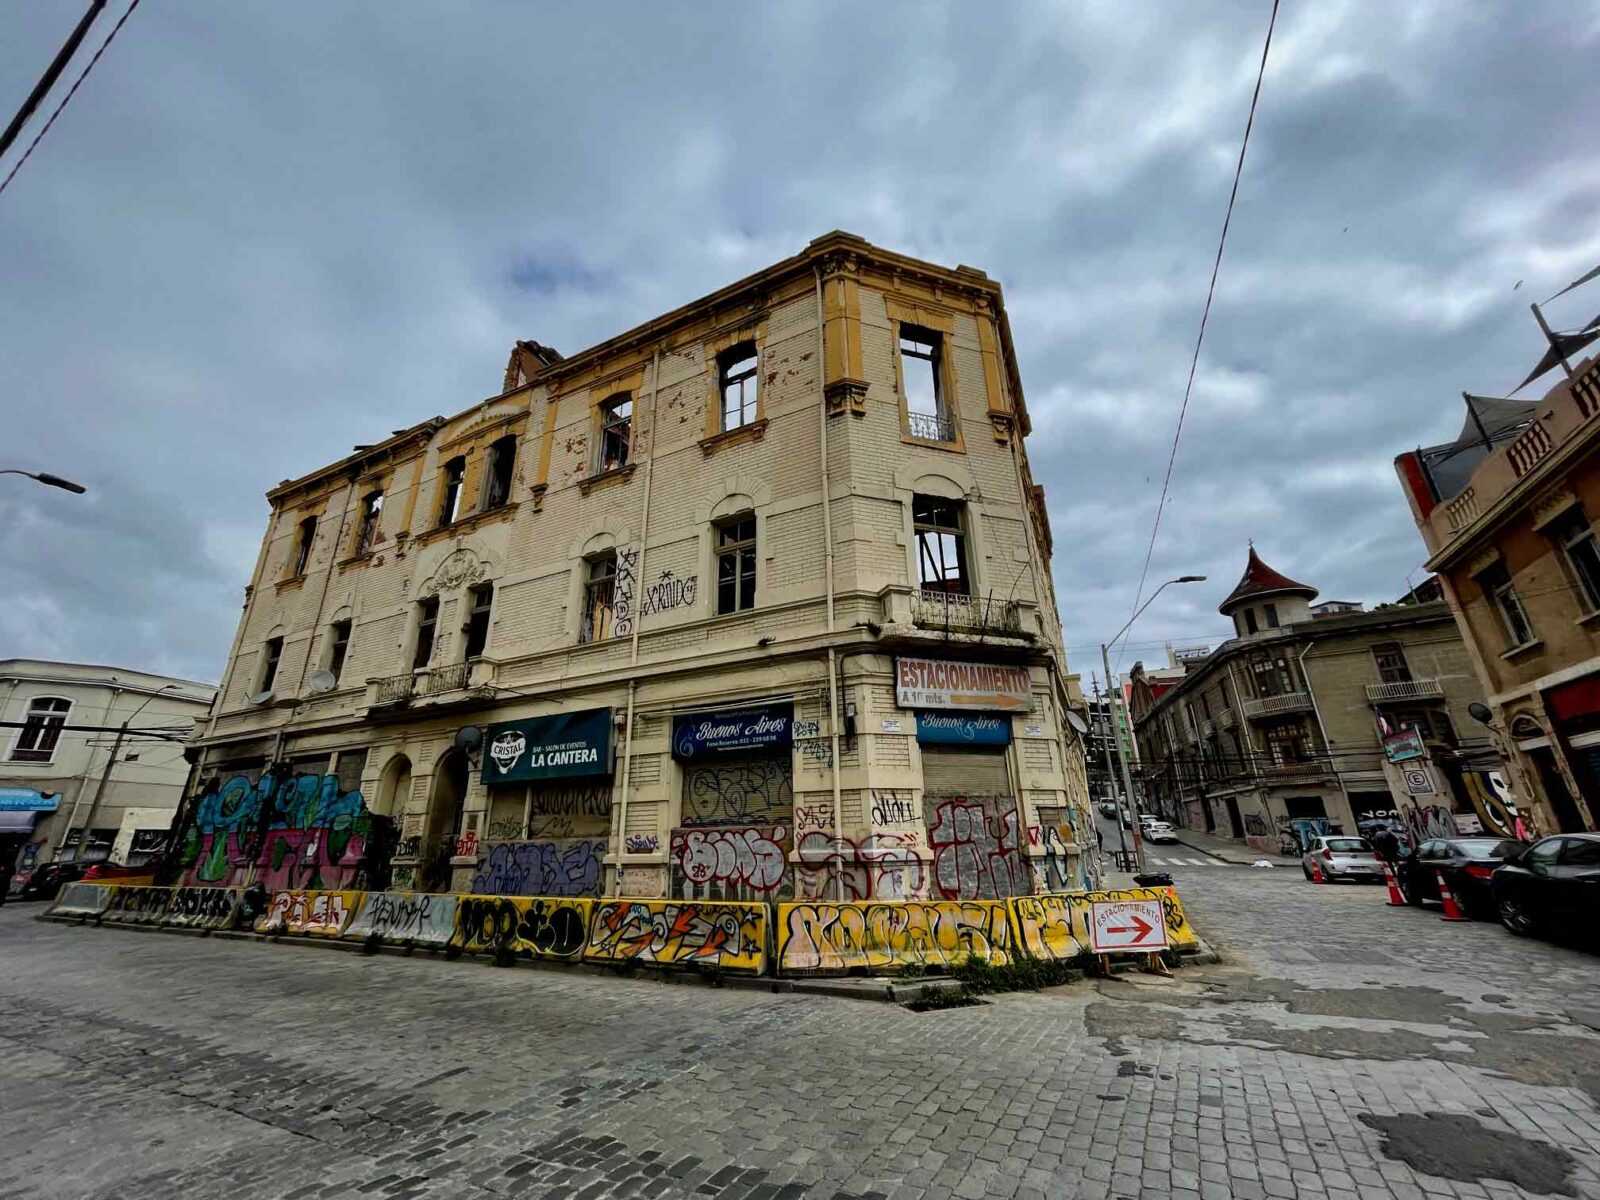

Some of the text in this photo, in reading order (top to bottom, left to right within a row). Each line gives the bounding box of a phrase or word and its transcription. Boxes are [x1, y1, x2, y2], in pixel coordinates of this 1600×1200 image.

[899, 661, 1031, 692] ESTACIONAMIENTO
[696, 721, 742, 740] Buenos
[745, 715, 787, 735] Aires
[922, 712, 1001, 729] Buenos Aires
[494, 743, 523, 756] CRISTAL
[531, 748, 598, 768] LA CANTERA
